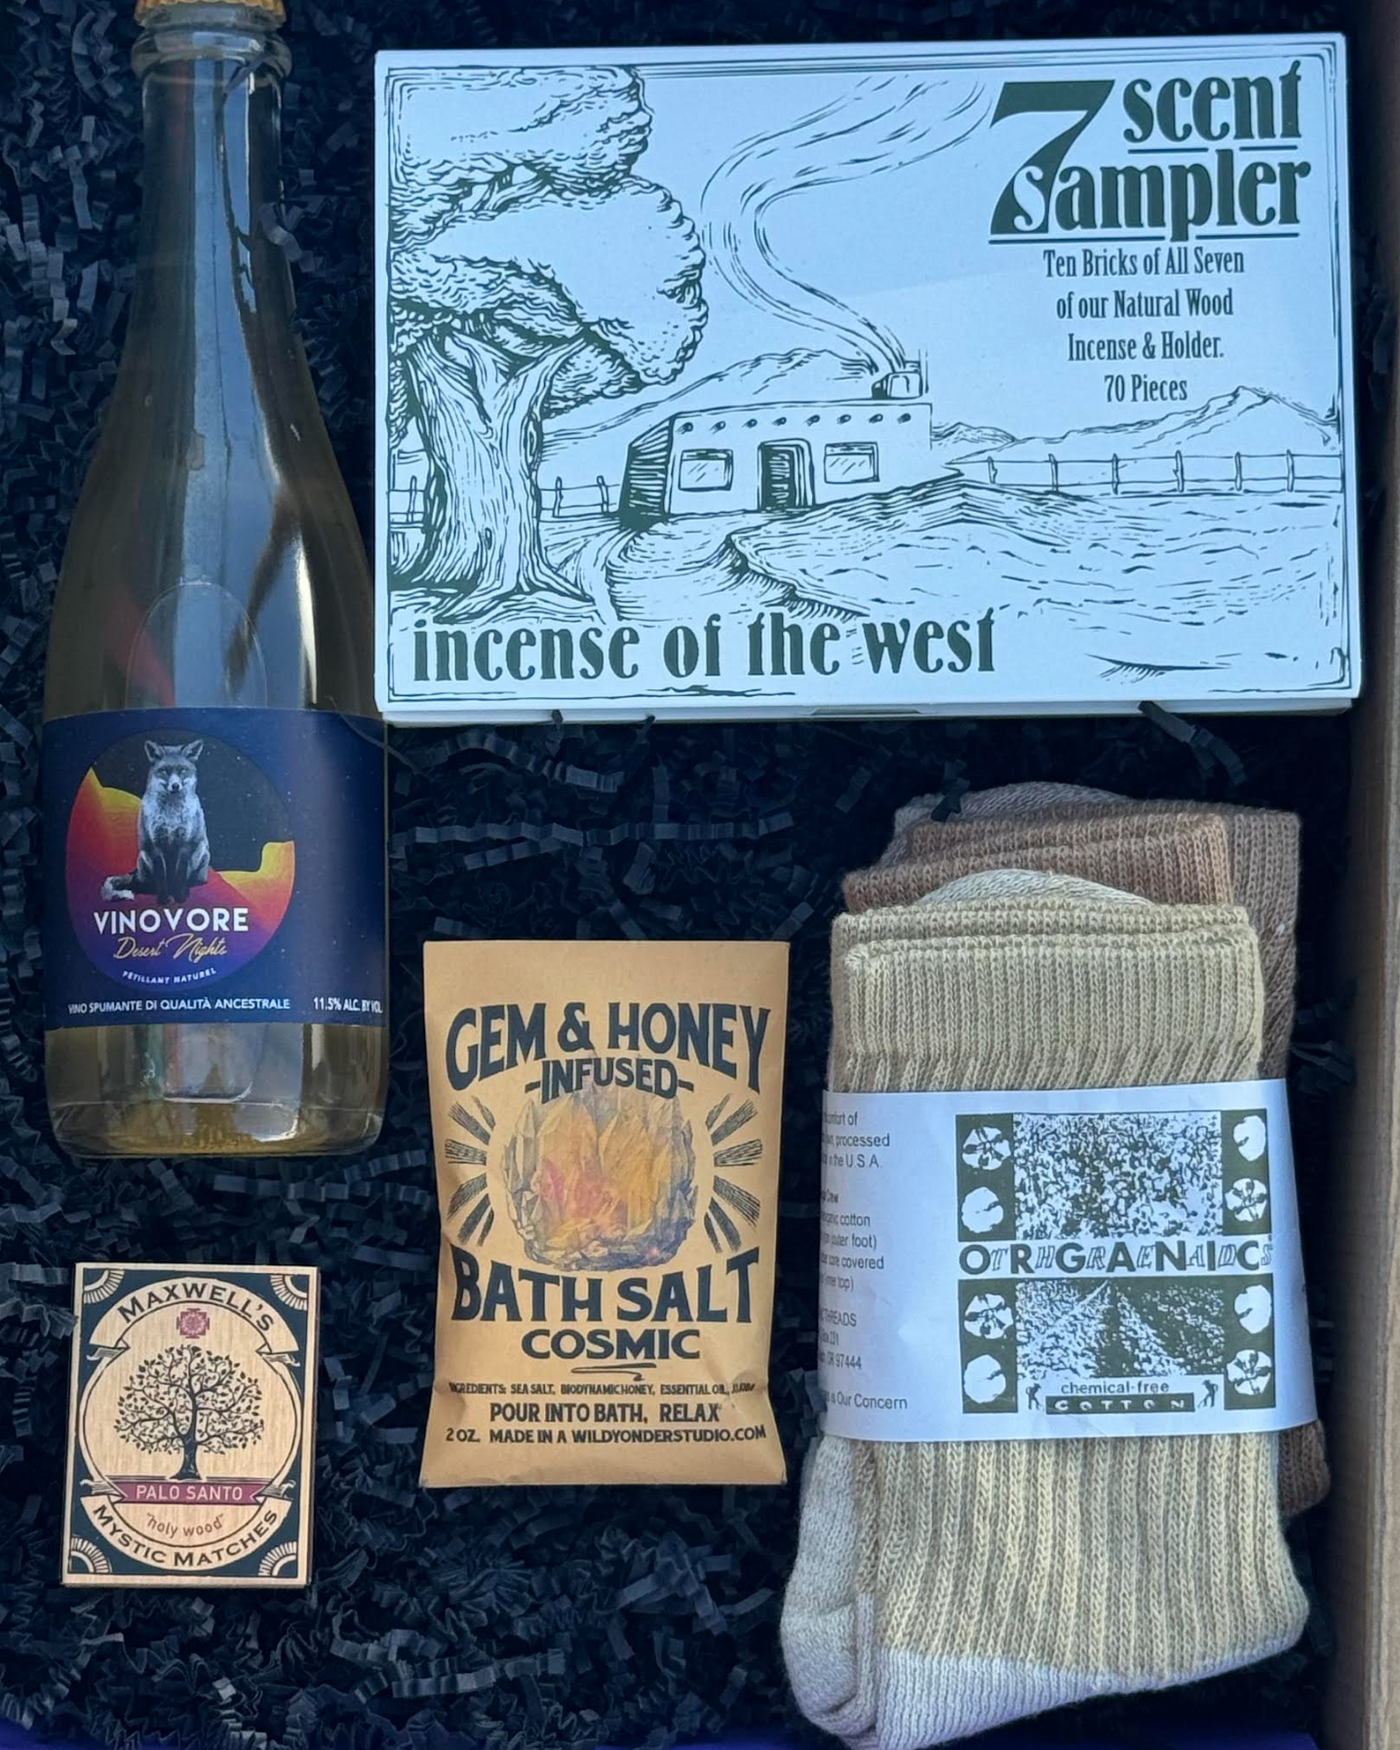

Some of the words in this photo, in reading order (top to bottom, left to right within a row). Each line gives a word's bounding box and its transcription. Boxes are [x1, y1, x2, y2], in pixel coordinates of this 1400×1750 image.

[989, 79, 1116, 235] 7
[1122, 60, 1302, 144] scent
[1012, 149, 1311, 242] Sampler
[1043, 249, 1077, 278] Ten
[1081, 248, 1138, 277] Bricks
[1143, 248, 1161, 275] of
[1164, 247, 1189, 275] All
[1194, 246, 1245, 274] Seven
[1056, 292, 1074, 319] of
[1078, 297, 1108, 319] our
[1113, 289, 1180, 318] Natural
[1185, 287, 1234, 315] Wood
[1067, 333, 1137, 361] Incense
[1142, 332, 1157, 360] &
[1161, 331, 1224, 359] Holder.
[1104, 374, 1126, 402] 70
[1131, 373, 1188, 400] Pieces
[413, 619, 640, 682] incense
[663, 611, 722, 679] of
[747, 611, 840, 676] the
[863, 607, 995, 674] west
[93, 907, 249, 935] VINOVORE
[113, 936, 167, 960] Desert
[165, 932, 228, 964] Nights
[68, 1003, 88, 1014] VINO
[89, 1000, 142, 1013] SPUMANTE
[145, 1000, 157, 1011] DI
[160, 996, 211, 1011] QUALITÀ
[214, 998, 291, 1010] ANCESTRALE
[313, 997, 342, 1011] 11.5%
[446, 1003, 547, 1091] GEM
[557, 1002, 595, 1052] &
[607, 1002, 771, 1094] HONEY
[836, 1132, 890, 1148] processed
[840, 1213, 871, 1227] cotton
[851, 1233, 877, 1251] foot)
[841, 1256, 885, 1270] covered
[450, 1244, 603, 1322] BATH
[616, 1247, 759, 1323] SALT
[117, 1282, 275, 1333] MAXWELL'S
[521, 1329, 700, 1359] COSMIC
[660, 1384, 710, 1395] ESSENTIAL
[836, 1391, 852, 1406] Our
[853, 1393, 909, 1410] Concern
[489, 1403, 541, 1422] POUR
[544, 1403, 590, 1422] INTO
[594, 1403, 648, 1424] BATH,
[659, 1402, 720, 1422] RELAX
[1054, 1399, 1185, 1412] COTTON
[446, 1427, 455, 1442] 2
[489, 1429, 534, 1443] MADE
[537, 1430, 553, 1443] IN
[556, 1430, 568, 1443] A
[571, 1424, 767, 1444] WILDYONDERSTUDIO.COM
[136, 1485, 180, 1500] PALO
[186, 1485, 243, 1501] SANTO
[93, 1503, 168, 1564] MYSTIC
[173, 1509, 278, 1568] MATCHES
